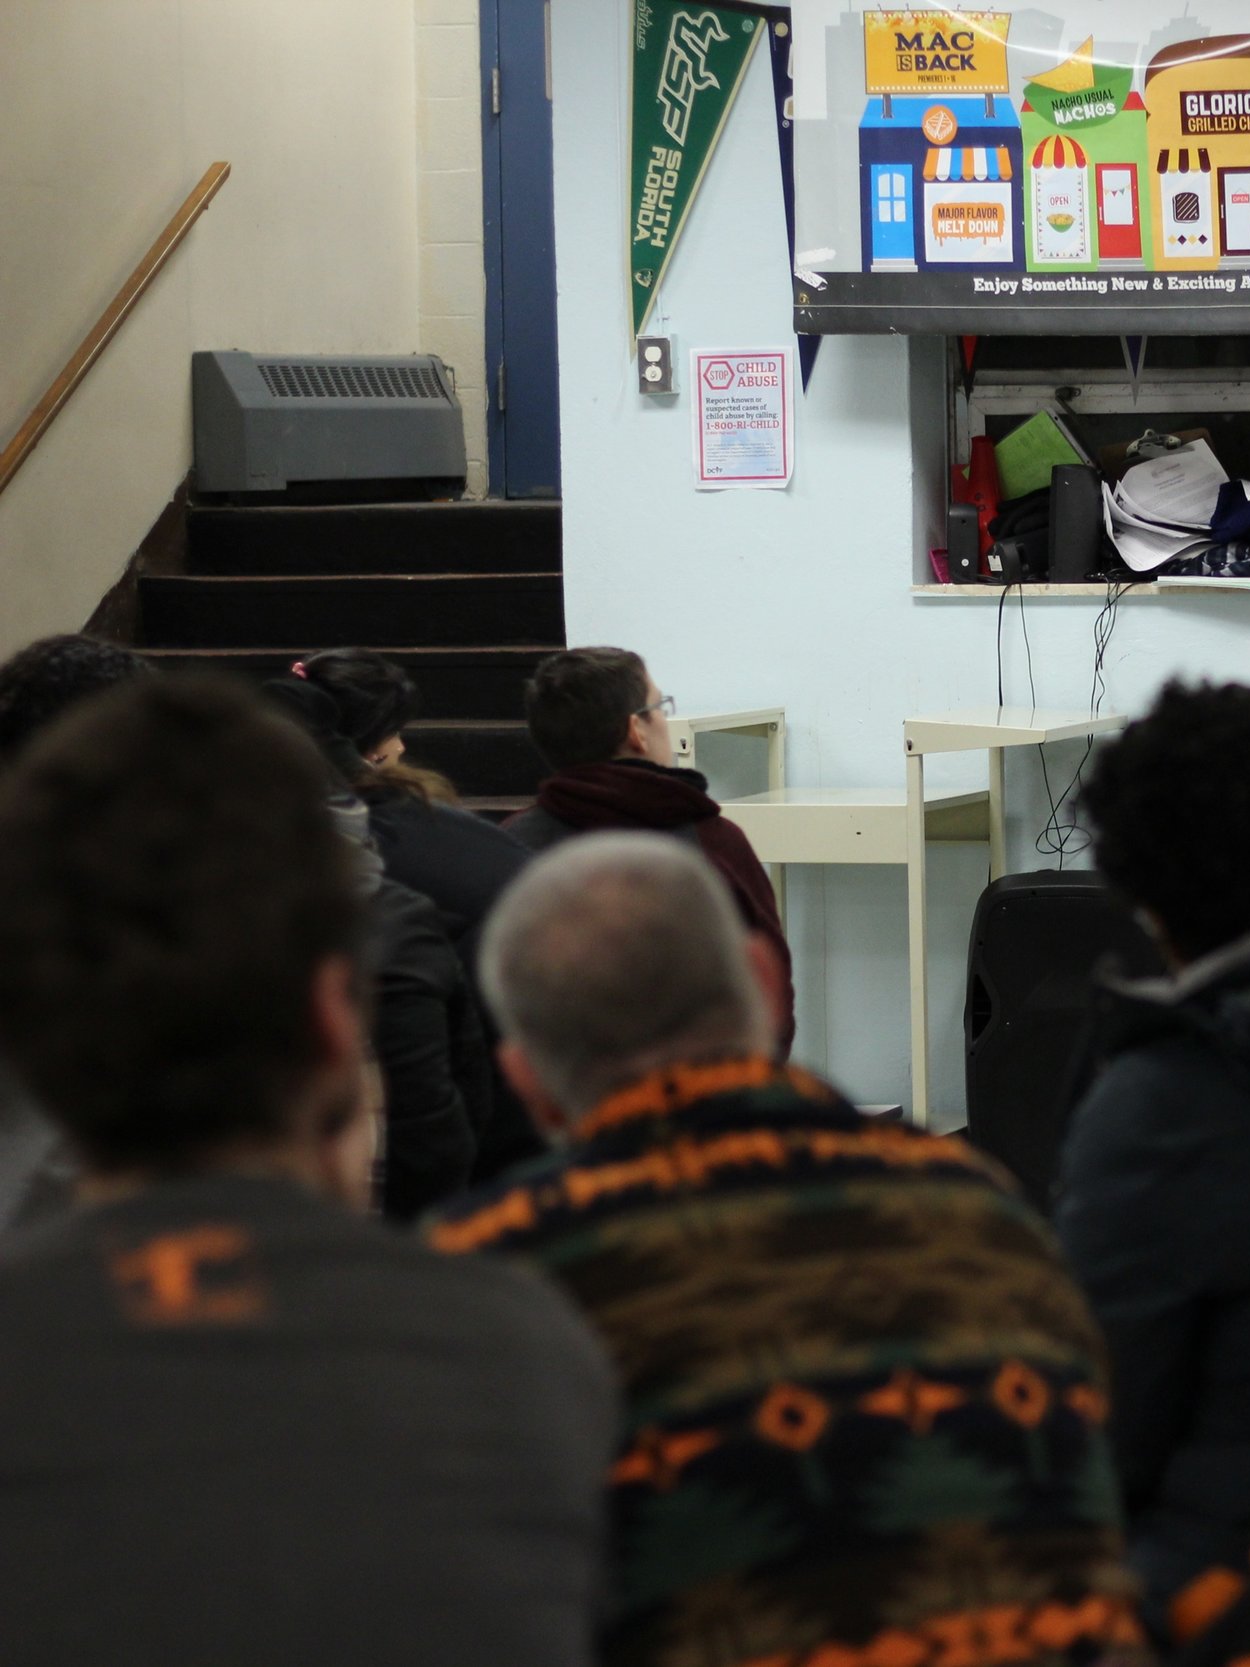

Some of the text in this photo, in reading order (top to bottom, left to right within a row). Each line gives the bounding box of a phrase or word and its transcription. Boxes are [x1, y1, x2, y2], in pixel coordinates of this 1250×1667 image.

[894, 32, 974, 51] MAC
[915, 54, 976, 71] BACK
[1051, 89, 1114, 110] NACHO USUAL
[1054, 103, 1117, 125] NACHOS
[1188, 117, 1237, 132] GRILLED
[634, 146, 666, 241] FLORIDA
[651, 149, 682, 248] SOUTH
[1050, 197, 1069, 206] OPEN
[938, 207, 998, 219] MAJOR FLAVOR
[938, 221, 999, 234] MELT DOWN
[974, 278, 1018, 294] Enjoy
[1022, 277, 1108, 294] Something
[1112, 277, 1148, 291] New
[1153, 277, 1164, 290] &
[1168, 276, 1236, 292] Exciting
[736, 362, 777, 373] CHILD
[709, 370, 729, 381] STOP
[737, 376, 778, 387] ABUSE
[706, 405, 740, 413] suspected
